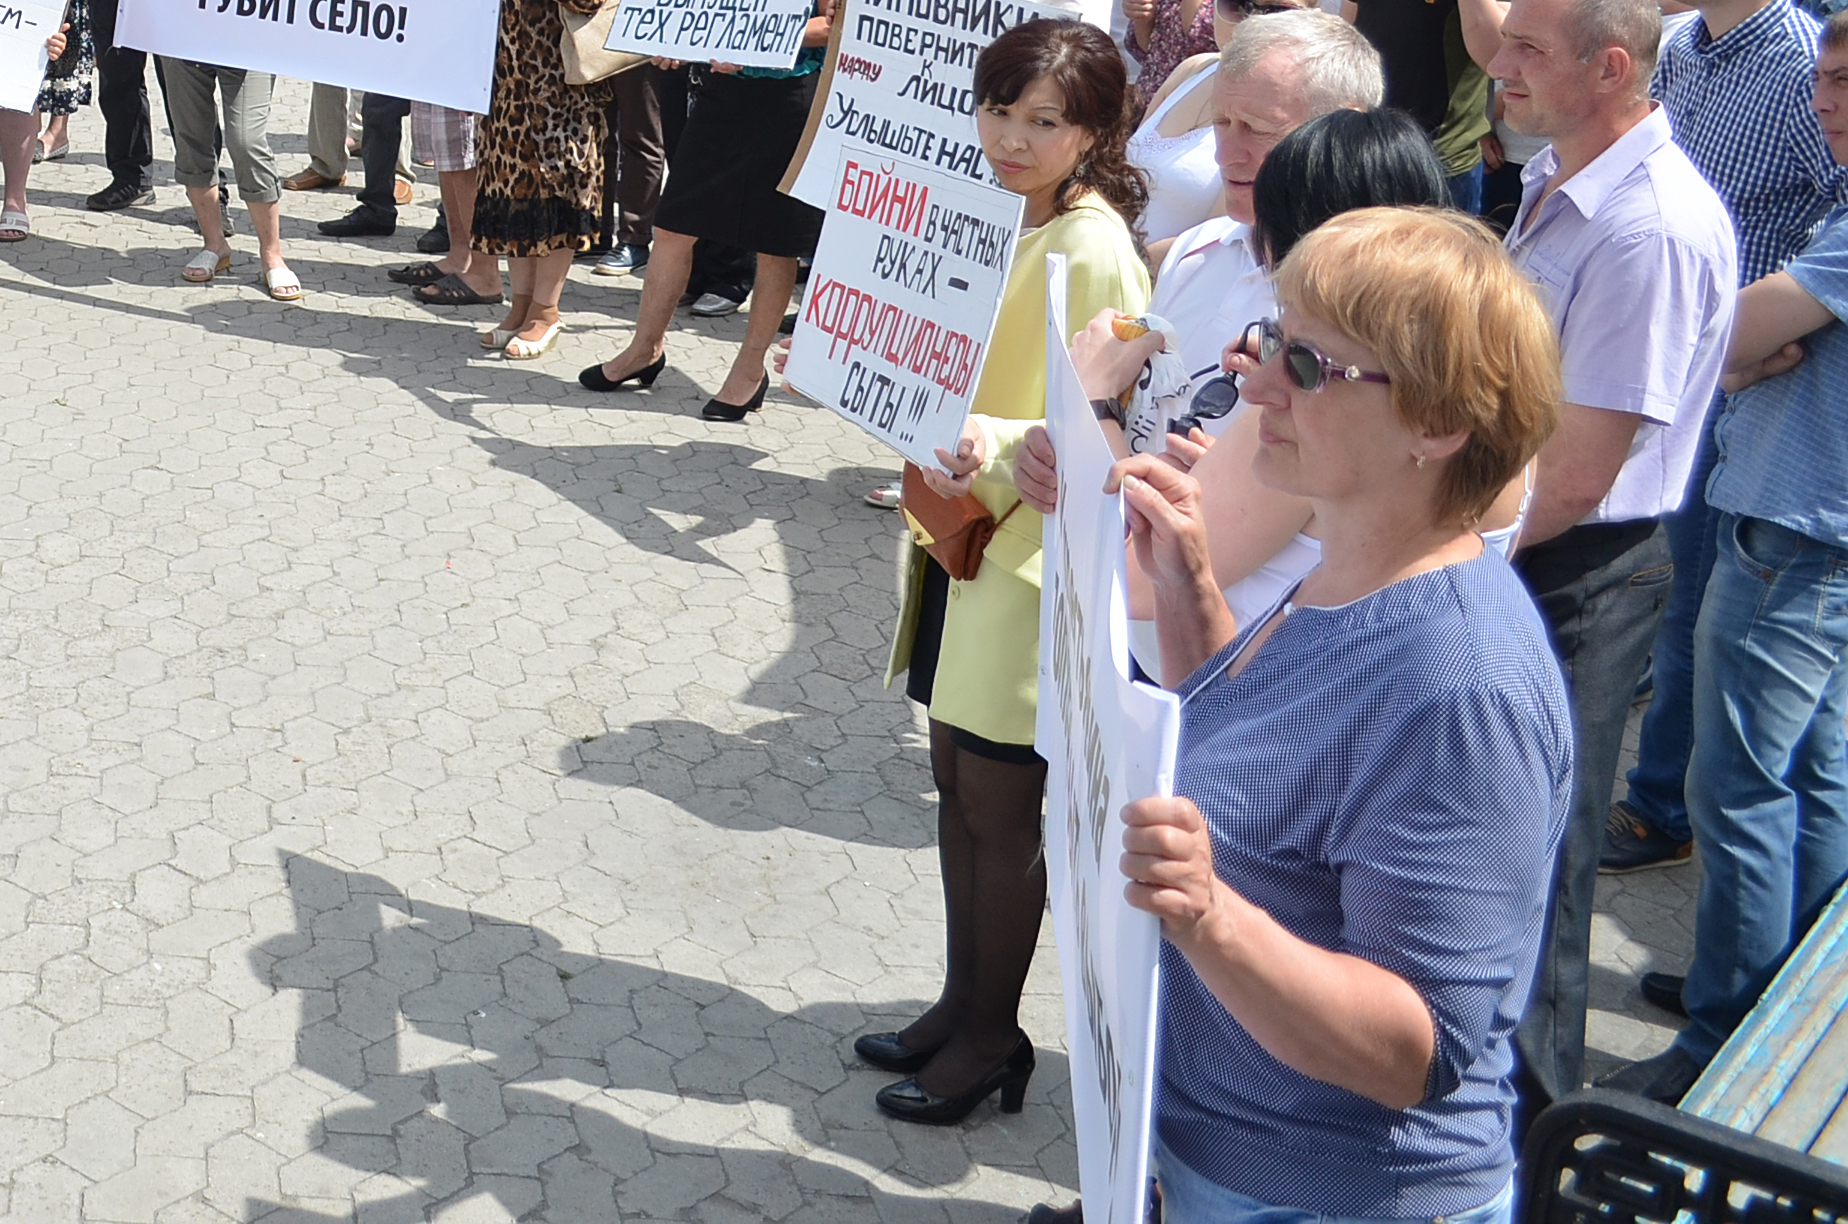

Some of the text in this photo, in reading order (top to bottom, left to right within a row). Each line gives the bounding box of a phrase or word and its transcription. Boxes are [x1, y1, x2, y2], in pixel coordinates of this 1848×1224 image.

[856, 14, 984, 69] ПОВЕРНИТ
[897, 74, 978, 117] ЛИЦО
[837, 160, 1012, 272] БОЙНИ В ЧАСТНЫХ
[872, 234, 943, 299] РУКАХ
[805, 273, 982, 414] КОРРУПЦИОНЕРЫ
[839, 361, 907, 434] СЫТЫ
